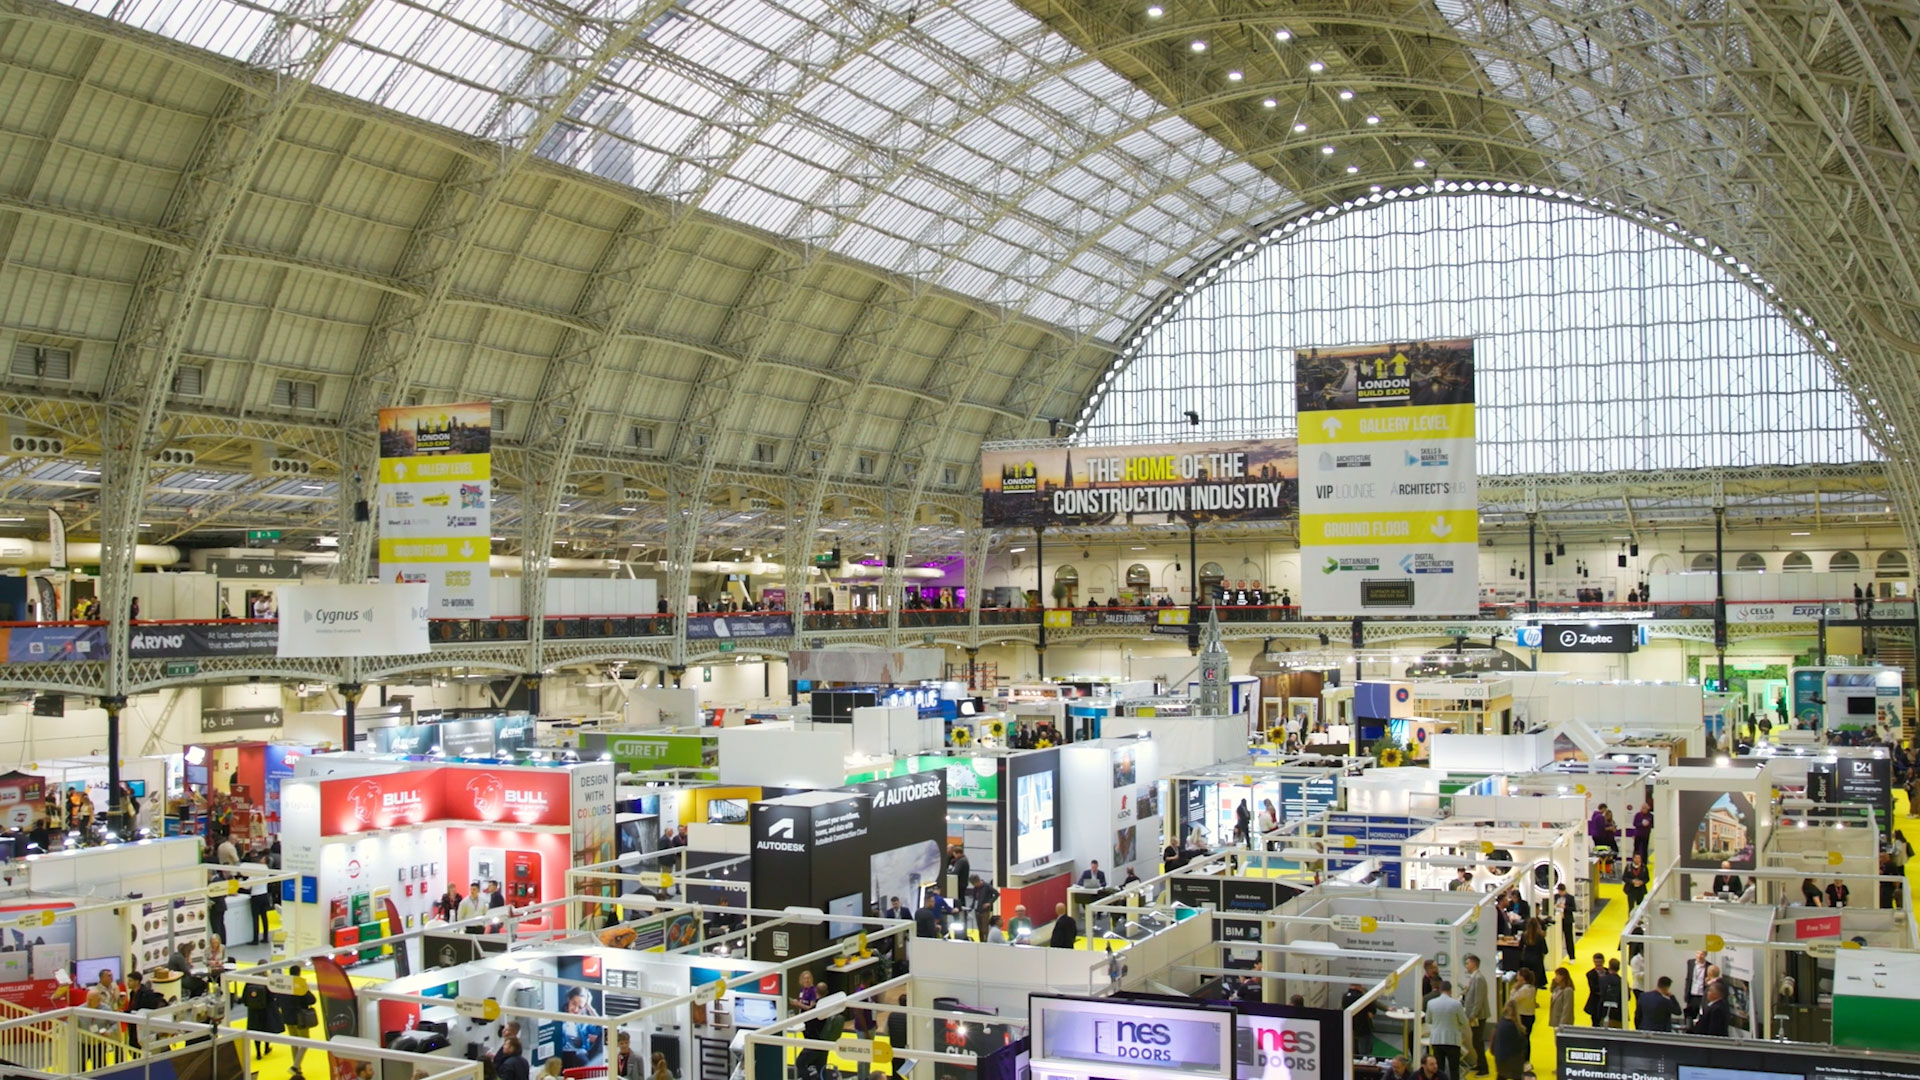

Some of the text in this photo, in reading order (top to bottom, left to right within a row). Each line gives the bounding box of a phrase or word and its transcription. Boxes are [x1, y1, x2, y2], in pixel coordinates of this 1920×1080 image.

[1358, 378, 1410, 390] LONDON
[1359, 414, 1449, 434] GALLERY LEVEL
[418, 433, 450, 441] LONDON
[418, 462, 474, 476] GALLERY LEVEL
[1087, 452, 1244, 482] THE HOME OF THE
[1002, 477, 1036, 486] LONDON
[1054, 482, 1282, 515] CONSTRUCTION INDUSTRY
[1316, 484, 1376, 499] VIP LOUNGE
[1324, 520, 1410, 538] GROUND FLOOR
[236, 564, 249, 573] Lift
[442, 599, 474, 607] CO-WORKING
[316, 608, 360, 624] Cygnus
[1105, 614, 1123, 622] SALES
[1124, 614, 1146, 622] LOUNGE
[145, 635, 183, 649] RYNO
[1527, 630, 1540, 645] hp
[1579, 634, 1613, 645] Zaptec
[223, 641, 249, 650] actually
[1464, 688, 1484, 696] D20
[221, 717, 234, 726] Lift
[614, 740, 669, 757] CURE IT
[580, 774, 608, 787] DESIGN
[382, 790, 421, 806] BULL
[504, 790, 548, 804] BULL
[585, 790, 604, 802] WITH
[886, 779, 941, 806] AUTODESK
[577, 804, 612, 819] COLOURS
[815, 818, 830, 828] Connect
[831, 817, 839, 826] your
[815, 827, 867, 846] Autodesk Construction Cloud
[757, 841, 805, 852] AUTODESK
[1226, 927, 1244, 936] BIM
[1117, 1019, 1172, 1045] nes
[1257, 1026, 1316, 1054] nes
[1118, 1046, 1171, 1062] DOORS
[1570, 1051, 1601, 1061] BUILDOTS
[1258, 1054, 1316, 1071] DOORS
[1566, 1068, 1665, 1080] Performance-Driven
